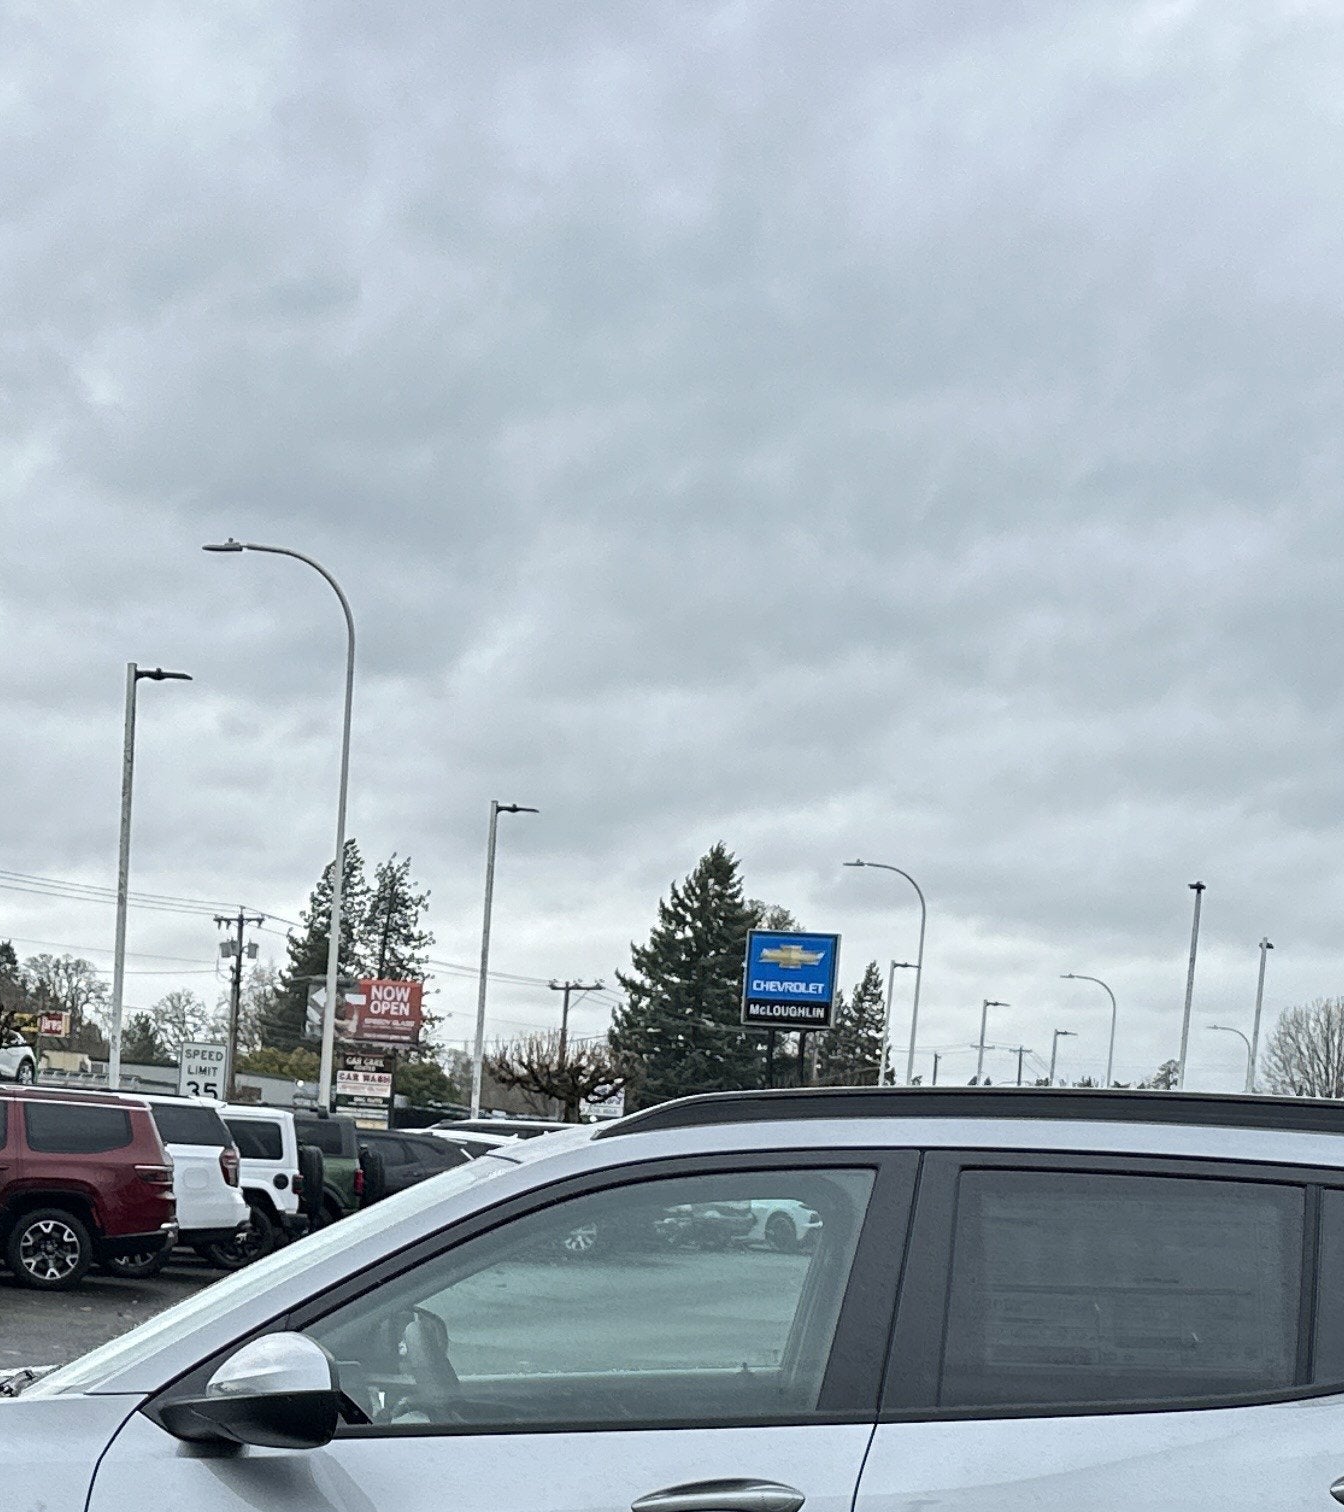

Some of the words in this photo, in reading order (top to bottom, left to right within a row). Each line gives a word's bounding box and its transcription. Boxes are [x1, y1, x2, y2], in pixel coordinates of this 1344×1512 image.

[371, 985, 411, 1002] NOW
[752, 979, 824, 994] CHEVROLET
[370, 1000, 410, 1016] OPEN
[749, 1003, 825, 1018] McLOUGHLIN
[185, 1049, 224, 1061] SPEED
[187, 1065, 218, 1077] LIMIT
[339, 1072, 359, 1081] CAR
